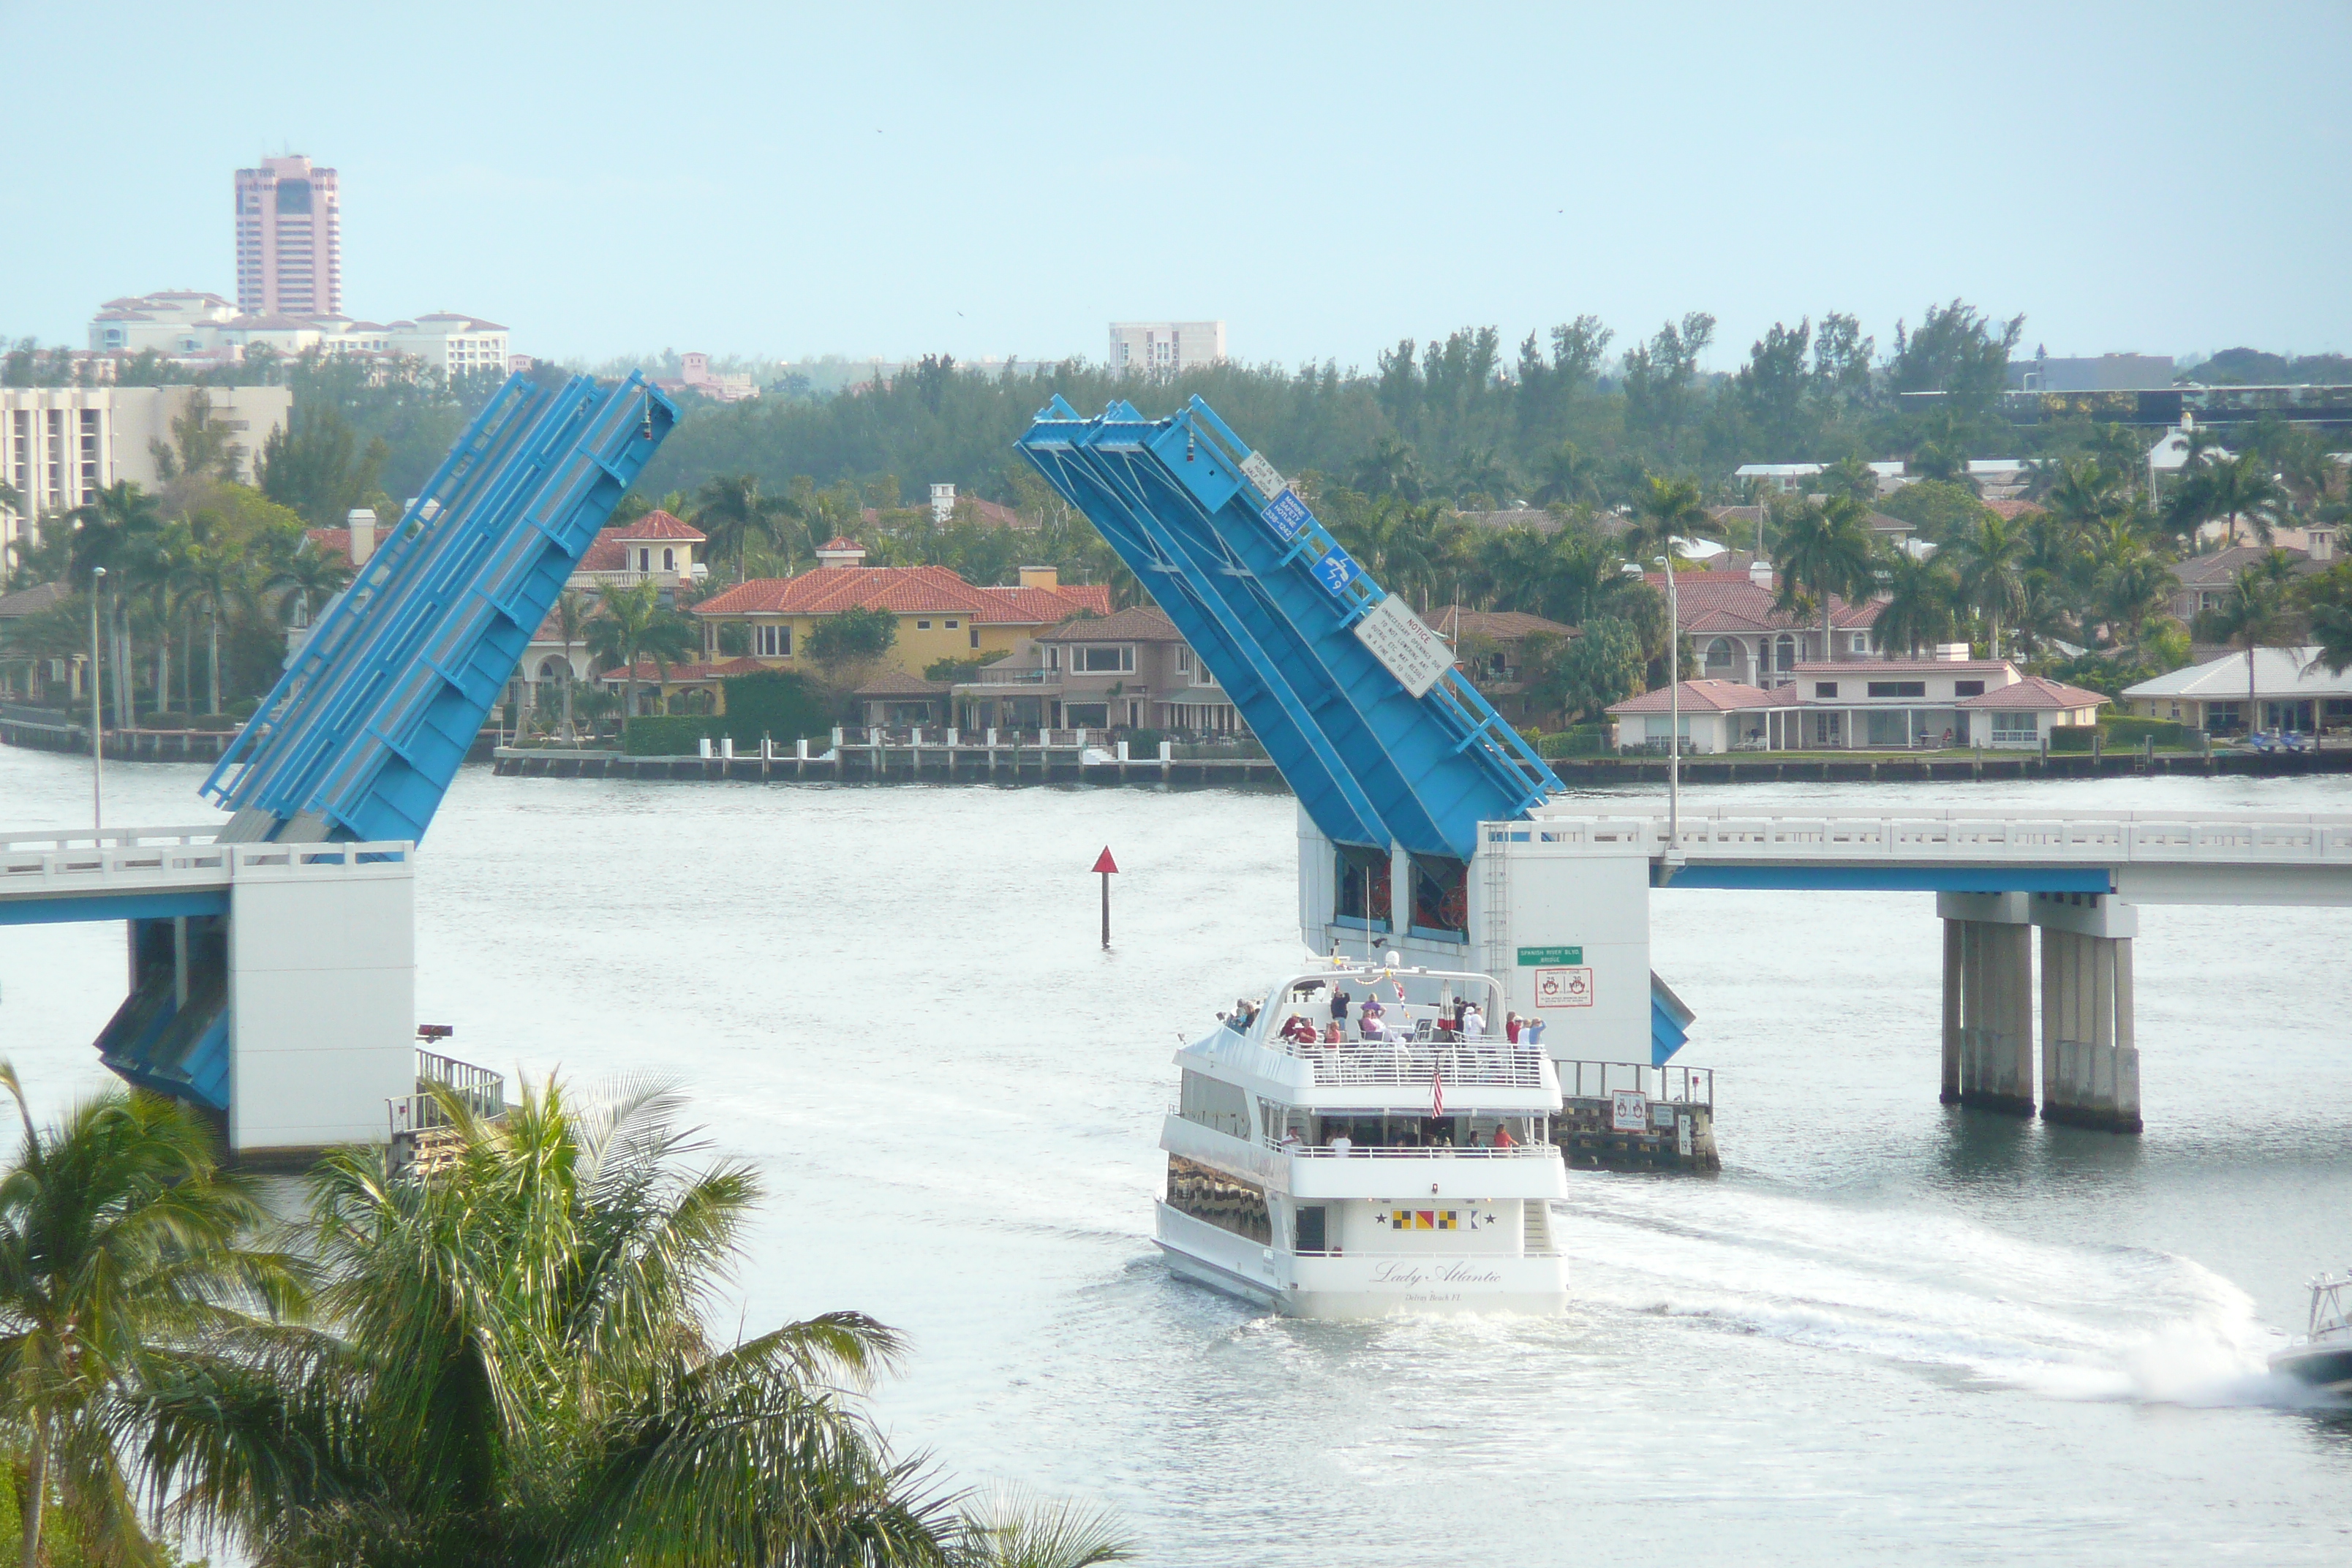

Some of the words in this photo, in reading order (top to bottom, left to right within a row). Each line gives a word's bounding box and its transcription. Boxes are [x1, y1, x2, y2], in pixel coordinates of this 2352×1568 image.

[1246, 466, 1257, 478] HALF
[1257, 479, 1270, 492] HOUR
[1254, 453, 1266, 467] OPEN
[1274, 475, 1284, 485] THE
[1254, 464, 1266, 478] HOUR
[1273, 505, 1296, 527] HOTLINE
[1279, 500, 1300, 521] SAFETY
[1284, 495, 1305, 516] MARINE
[1264, 509, 1292, 536] 338-1242
[1332, 580, 1341, 590] 9
[1381, 607, 1410, 637] UNNECESSARY
[1410, 638, 1431, 660] OPENINGS
[1431, 660, 1441, 670] DUE
[1406, 618, 1431, 644] NOTICE
[1377, 644, 1388, 656] FINE
[1388, 655, 1396, 664] UP
[1387, 627, 1397, 637] NOT
[1397, 638, 1419, 660] LOWERING
[1398, 652, 1408, 663] MAY
[1408, 663, 1425, 680] RESULT
[1681, 1120, 1686, 1130] 17
[1681, 1140, 1687, 1150] 19
[1369, 1261, 1422, 1289] Lady
[1425, 1261, 1501, 1282] Atlantic
